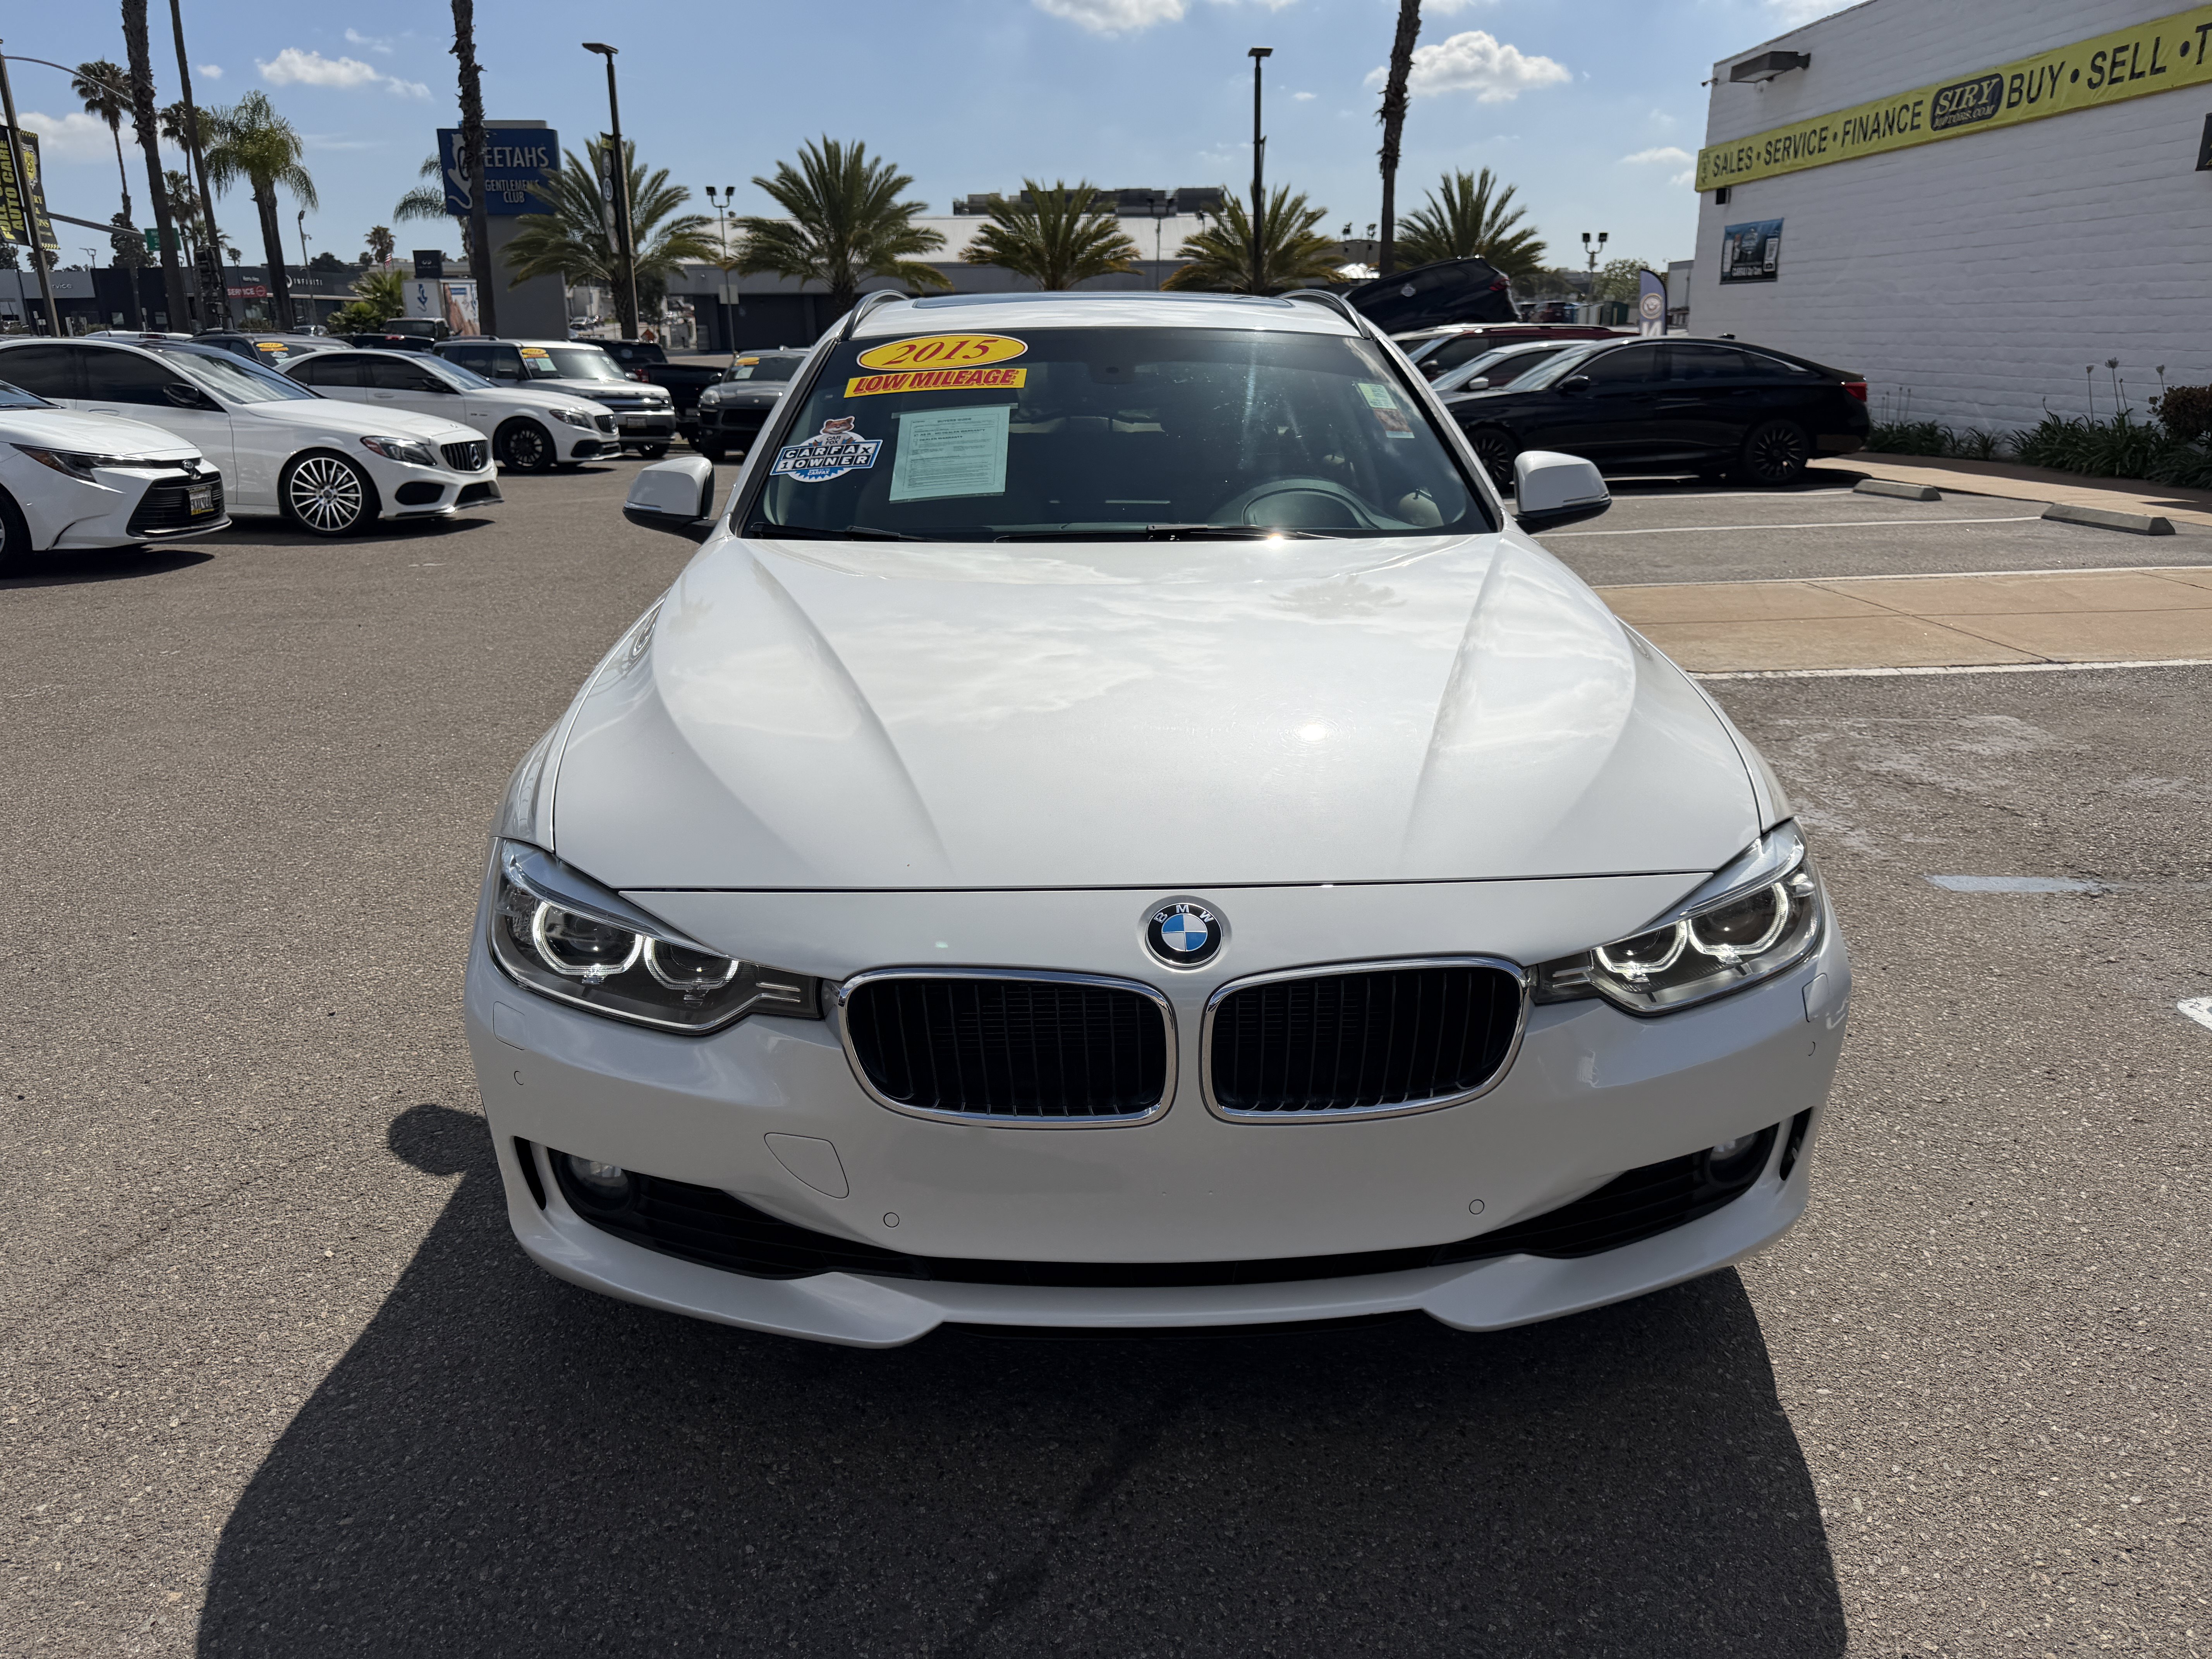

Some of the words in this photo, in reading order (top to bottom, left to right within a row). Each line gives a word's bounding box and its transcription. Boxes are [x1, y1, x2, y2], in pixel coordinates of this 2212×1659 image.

[2006, 60, 2066, 109] BUY
[2087, 36, 2167, 90] SELL
[1936, 77, 2001, 115] SIRY
[1712, 146, 1753, 178] SALES
[1763, 126, 1829, 166] SERVICE
[1841, 100, 1924, 148] FINANCE
[0, 140, 15, 184] CARE
[483, 146, 549, 167] EETAHS
[5, 187, 25, 231] AUTO
[503, 191, 525, 203] CLUB
[227, 288, 255, 296] SERVICE
[881, 339, 1000, 366] 2015
[853, 373, 912, 394] LOW
[909, 369, 1019, 388] MILEAGE
[785, 446, 872, 459] CARFAX
[795, 456, 867, 468] OWNER
[1153, 904, 1214, 924] BMW
